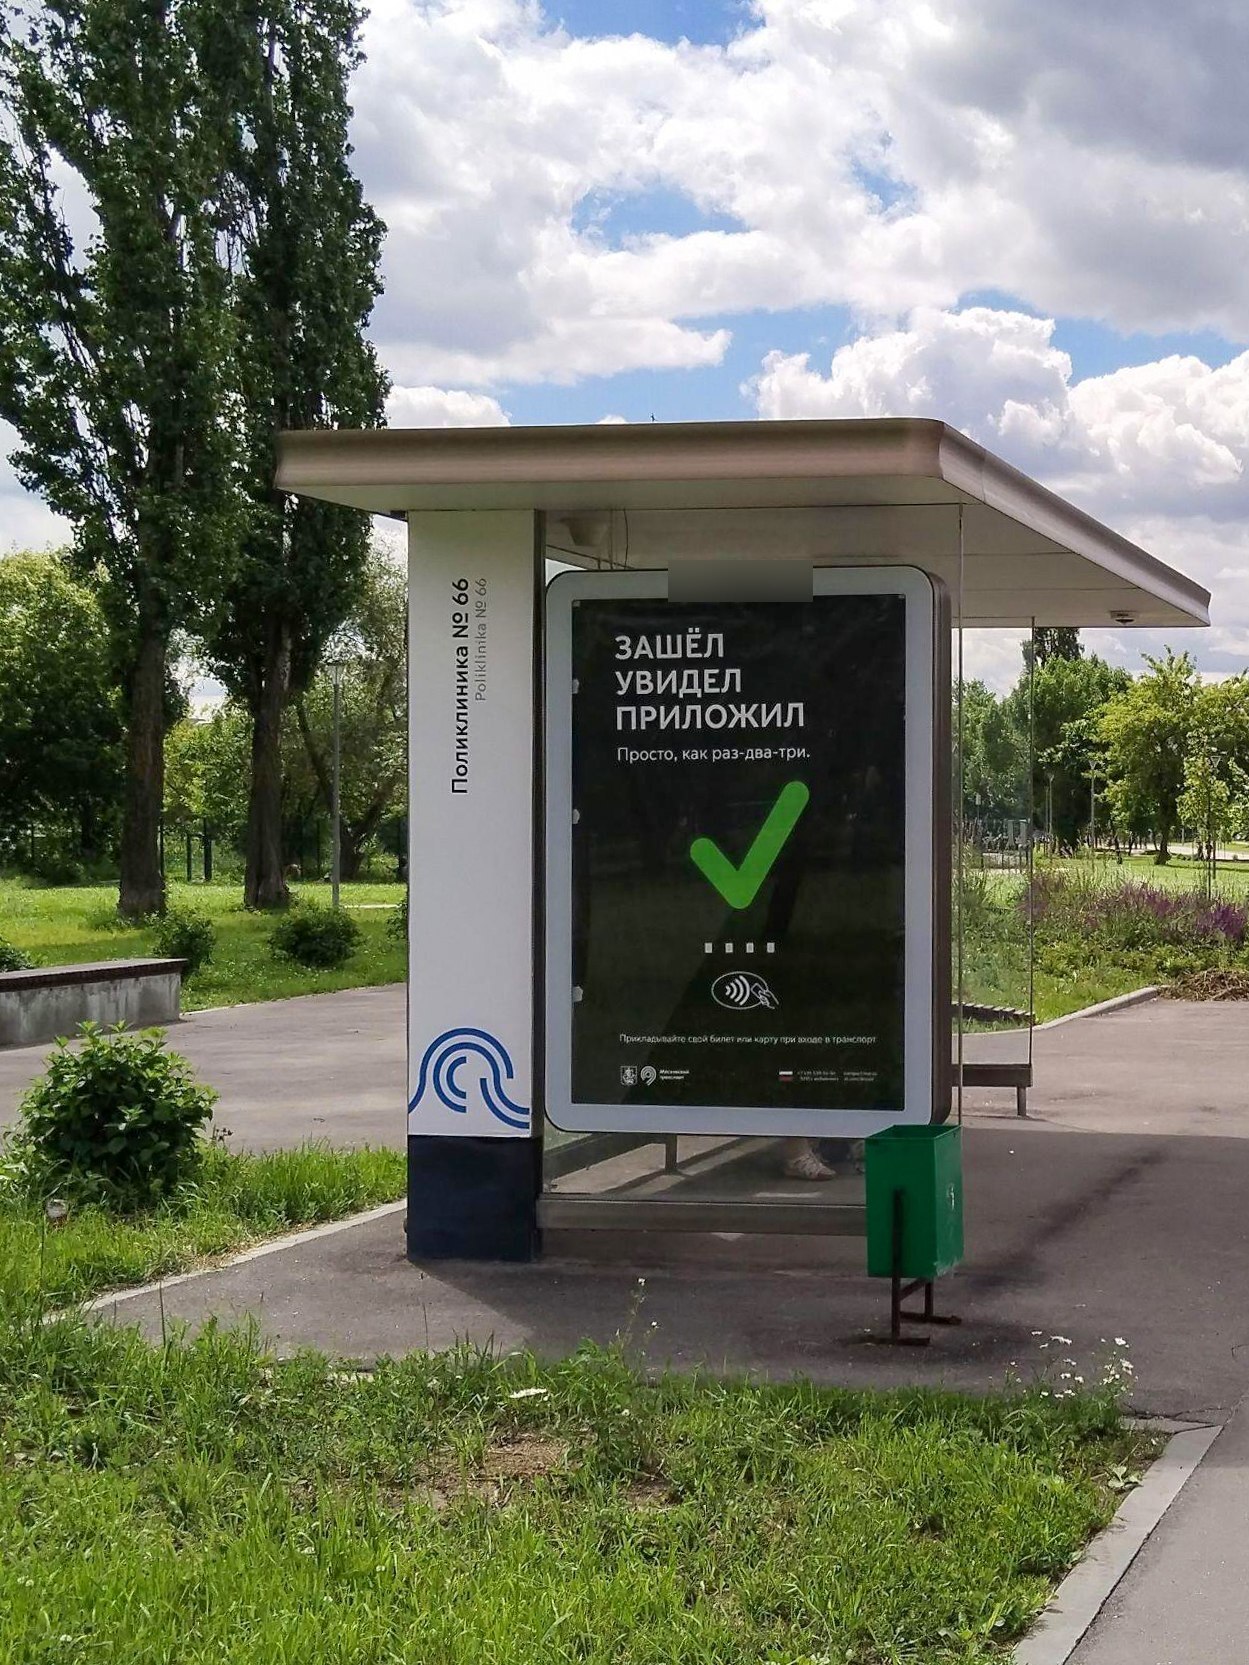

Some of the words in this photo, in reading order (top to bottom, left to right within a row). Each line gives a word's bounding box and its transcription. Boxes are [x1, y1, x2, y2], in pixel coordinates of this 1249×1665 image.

[452, 578, 469, 607] 66
[475, 578, 487, 597] 66
[475, 601, 487, 618] №
[452, 611, 469, 638] №
[614, 628, 724, 660] ЗАШЁЛ
[475, 622, 487, 702] Poliklinika
[615, 668, 741, 698] УВИДЕЛ
[452, 645, 469, 794] Поликлиника
[617, 704, 804, 730] ПРИЛОЖИЛ
[617, 747, 678, 763] Просто,
[682, 749, 708, 761] как
[712, 746, 811, 763] раз-два-три.
[710, 1034, 734, 1043] билет
